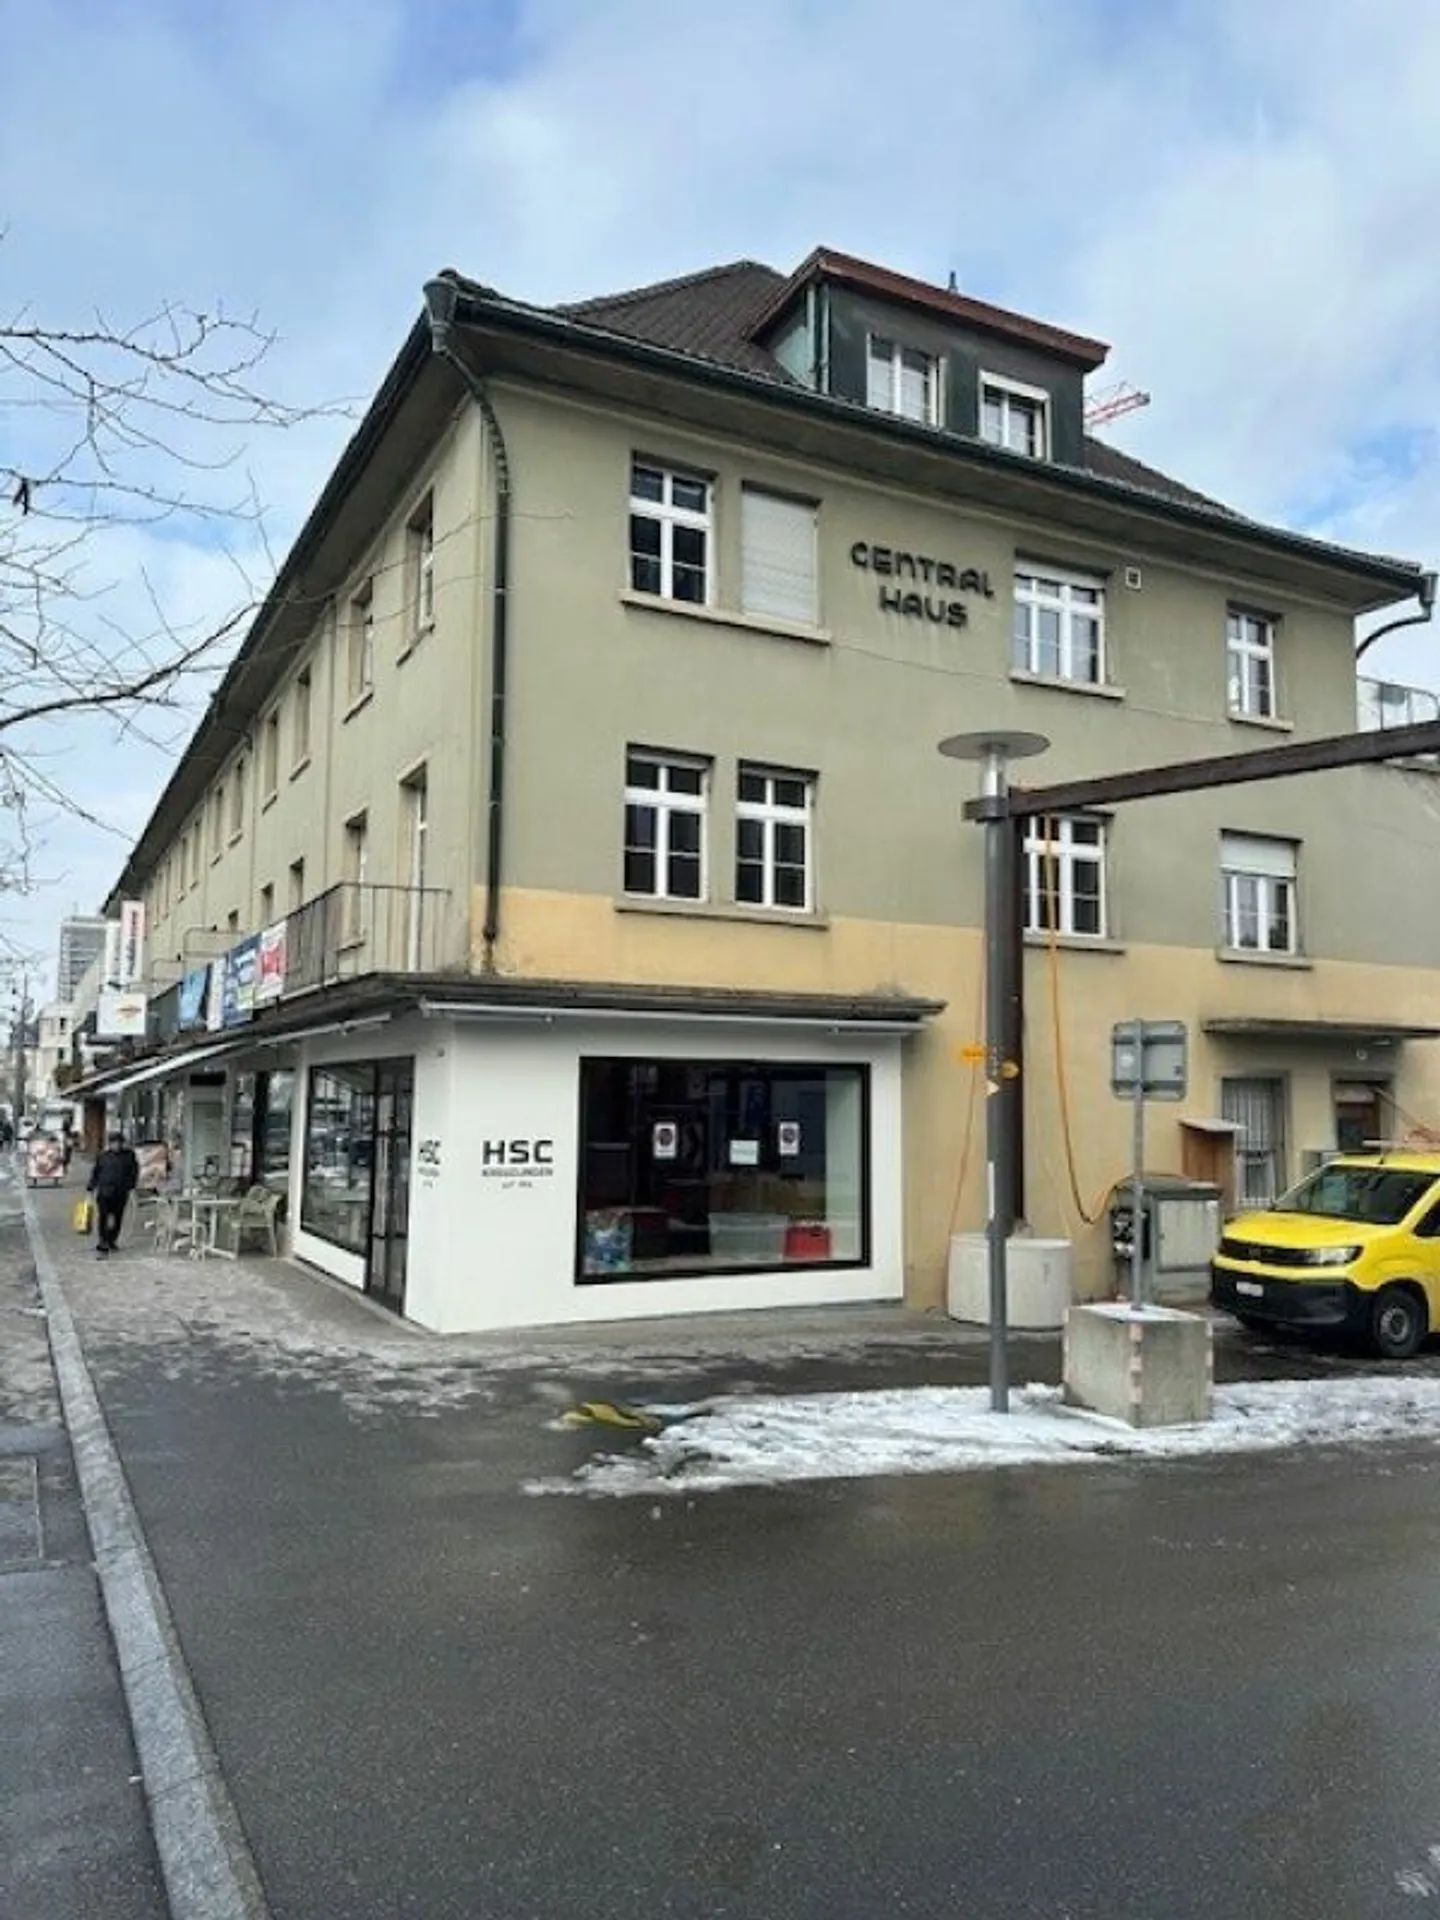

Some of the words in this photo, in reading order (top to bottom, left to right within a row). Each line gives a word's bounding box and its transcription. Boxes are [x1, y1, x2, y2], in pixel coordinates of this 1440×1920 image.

[851, 541, 994, 598] CENTRAL
[879, 585, 968, 628] HAUS
[482, 1140, 554, 1165] HSC
